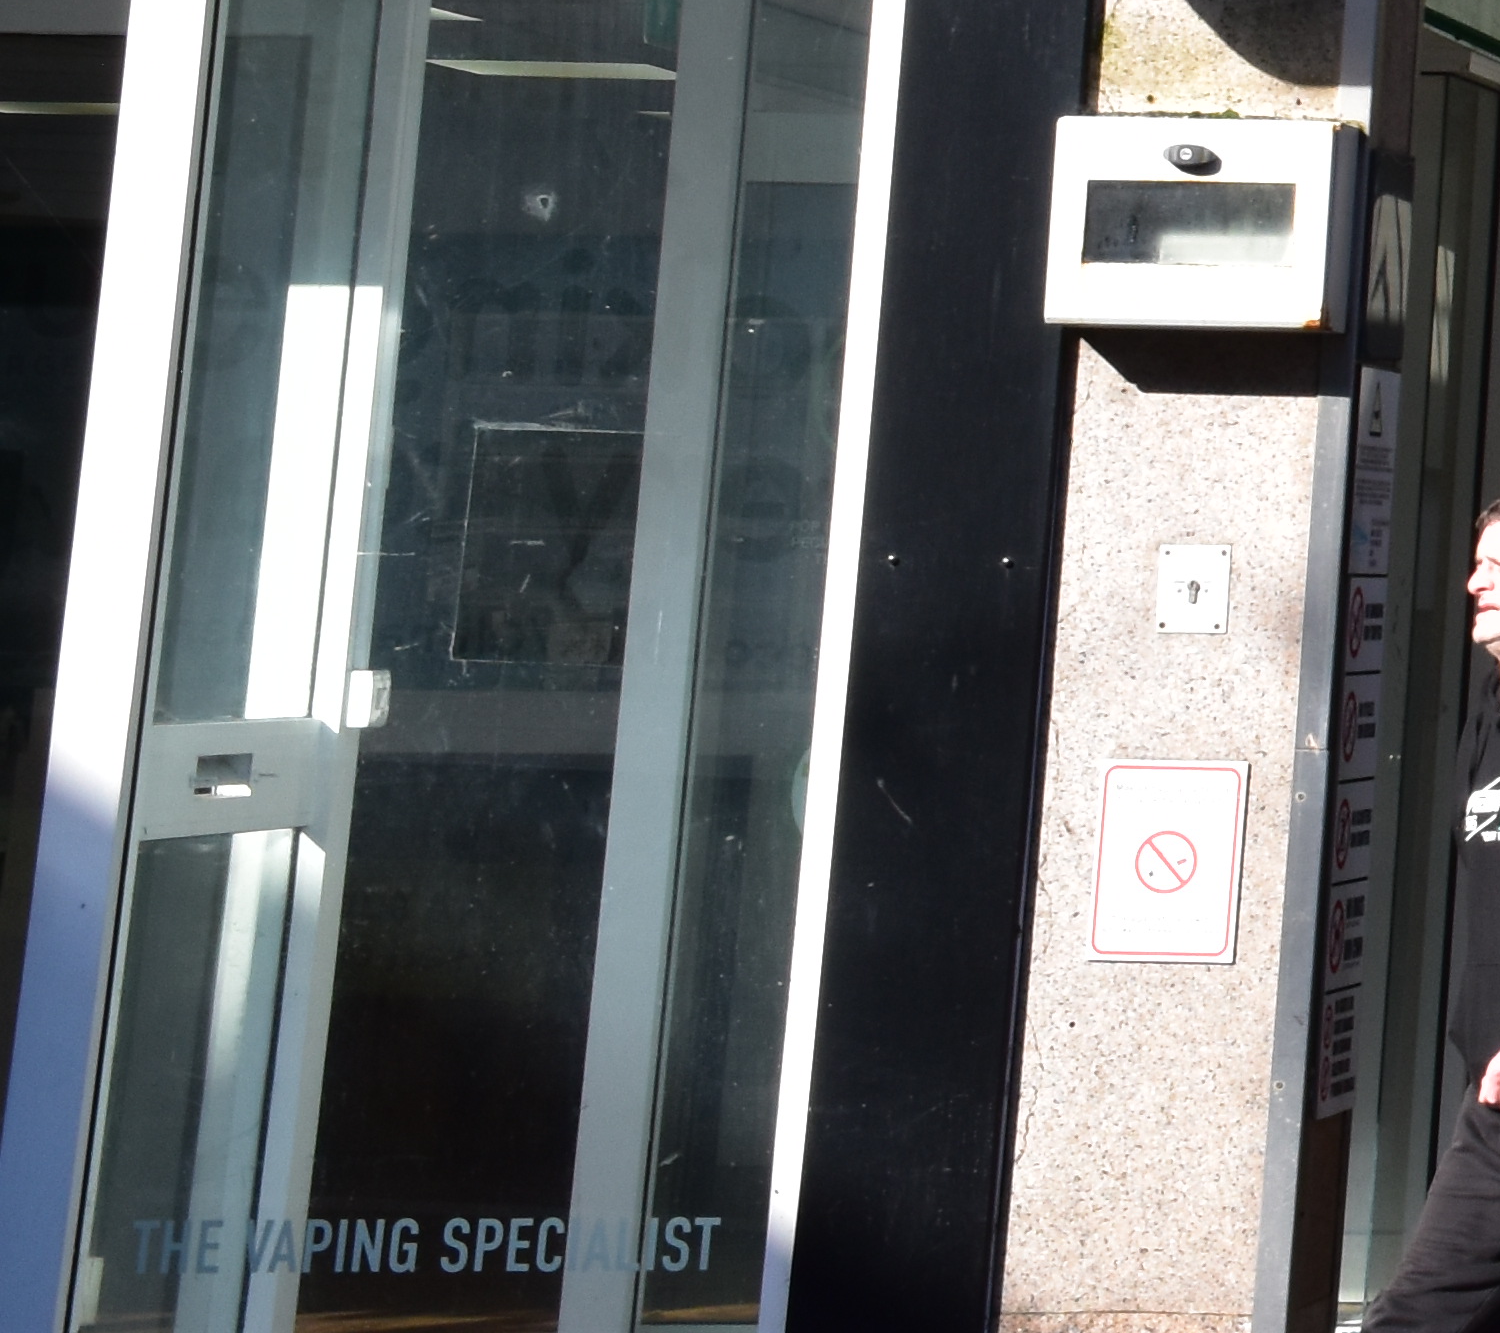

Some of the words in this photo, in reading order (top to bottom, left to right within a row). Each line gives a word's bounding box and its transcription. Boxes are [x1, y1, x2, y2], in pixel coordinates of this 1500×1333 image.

[131, 1218, 226, 1275] THE
[244, 1217, 421, 1275] VAPING
[440, 1216, 722, 1274] SPECIALIST
